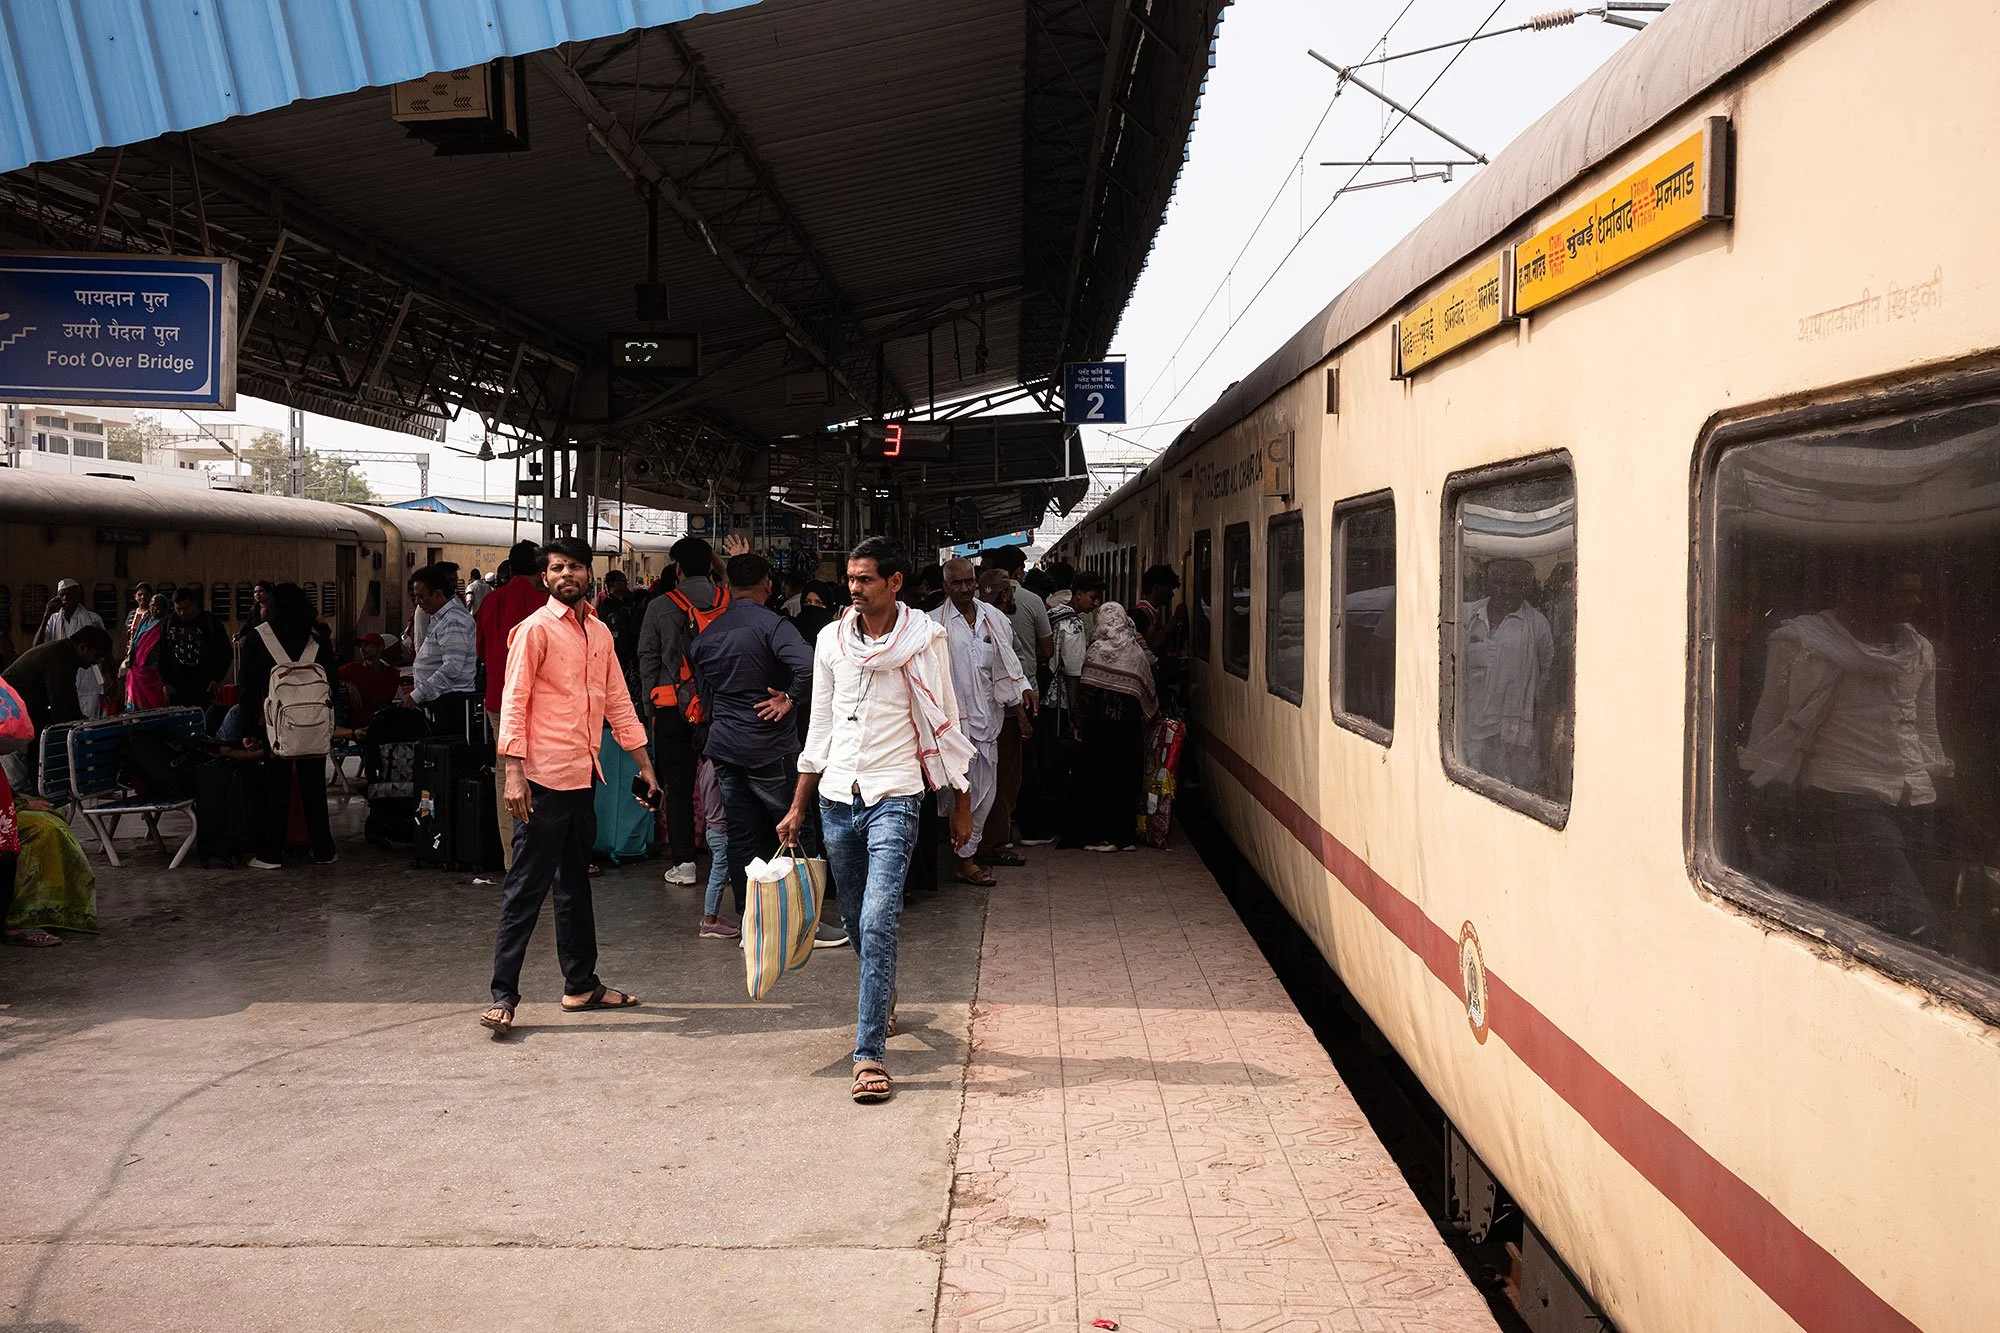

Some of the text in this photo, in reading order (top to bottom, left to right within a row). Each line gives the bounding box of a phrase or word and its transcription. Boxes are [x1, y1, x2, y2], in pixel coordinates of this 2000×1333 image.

[1566, 216, 1594, 259] मुंबई
[1655, 161, 1695, 210] मनमाड
[74, 290, 169, 313] पायदान पुल
[62, 317, 181, 347] उपरी पैदल पुल
[47, 350, 194, 374] Foot Over Bridge
[1086, 392, 1105, 419] 2
[883, 424, 902, 456] 3
